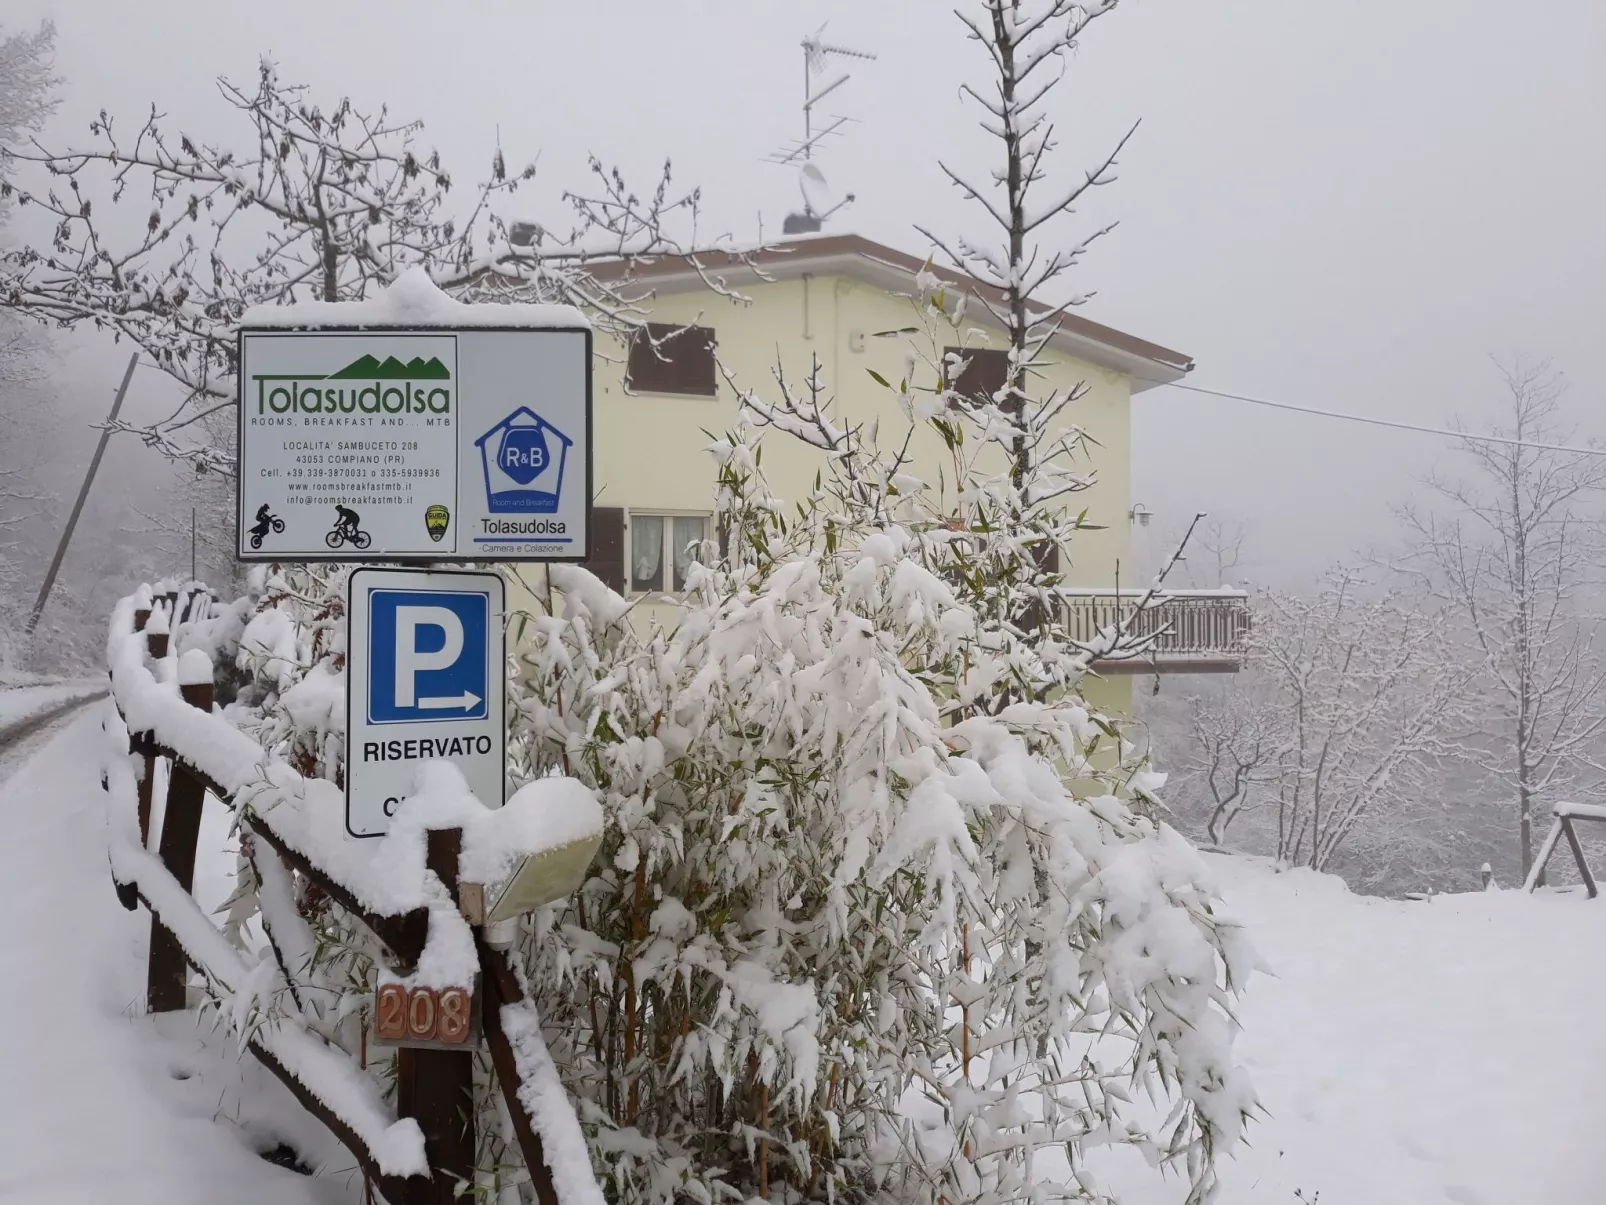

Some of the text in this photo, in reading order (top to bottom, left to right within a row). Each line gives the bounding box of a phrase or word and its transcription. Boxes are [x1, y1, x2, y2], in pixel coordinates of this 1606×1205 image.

[252, 375, 450, 414] Tolasudolsa
[251, 418, 298, 427] ROOMS,
[304, 418, 373, 426] BREAKFAST
[426, 418, 451, 426] MTB
[283, 441, 418, 450] LOCALITA' SAMBUCETO 208
[296, 455, 405, 465] 43053 COMPIANO (PR)
[506, 447, 543, 467] R&B
[260, 469, 282, 477] Cell.
[288, 482, 412, 491] www.roomsbreakfastmtb.it
[286, 496, 413, 505] info@roomsbreakfastmtb.it
[481, 519, 566, 534] Tolasudolsa
[482, 545, 514, 553] Camera
[525, 545, 563, 553] Colazione
[394, 605, 465, 708] P
[363, 735, 492, 762] RISERVATO
[380, 988, 461, 1036] 208
